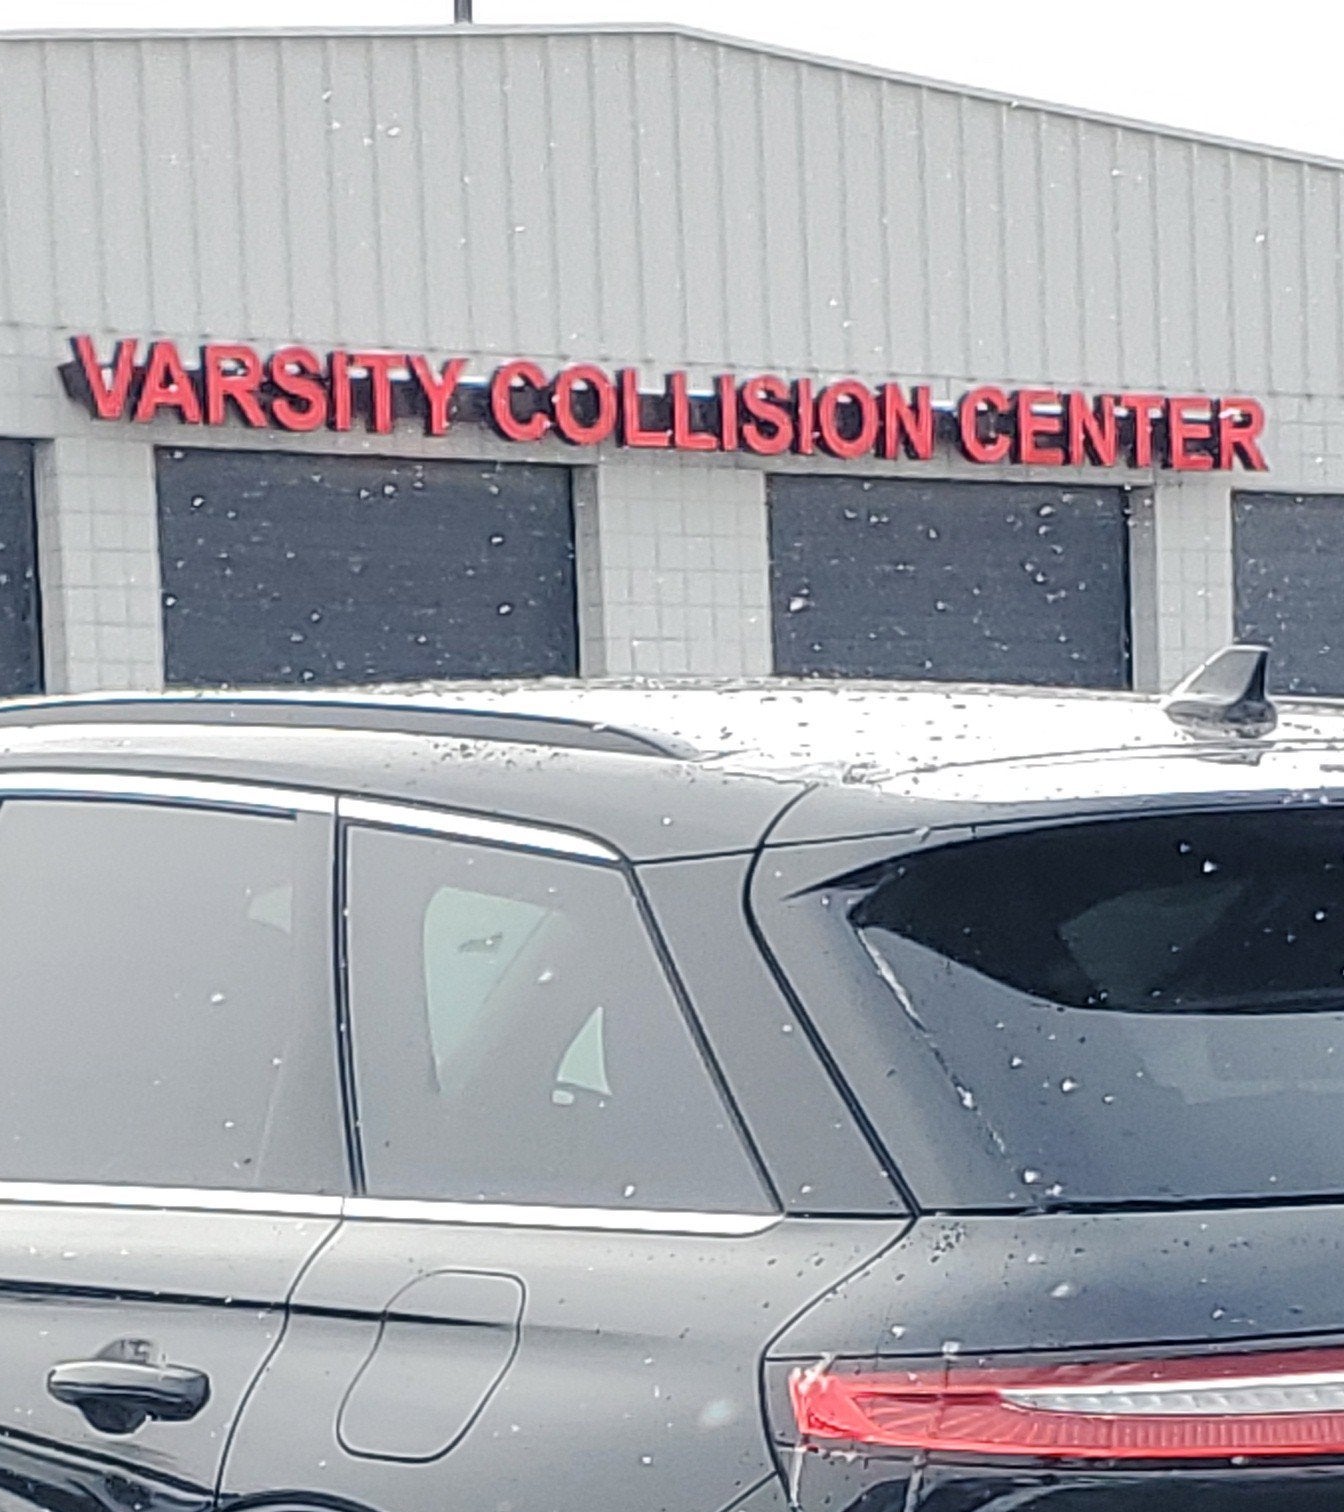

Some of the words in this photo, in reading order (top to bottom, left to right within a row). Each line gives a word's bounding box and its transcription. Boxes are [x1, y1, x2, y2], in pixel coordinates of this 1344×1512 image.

[71, 335, 466, 436] VARSITY
[490, 360, 934, 461] COLLISION
[959, 386, 1267, 471] CENTER
